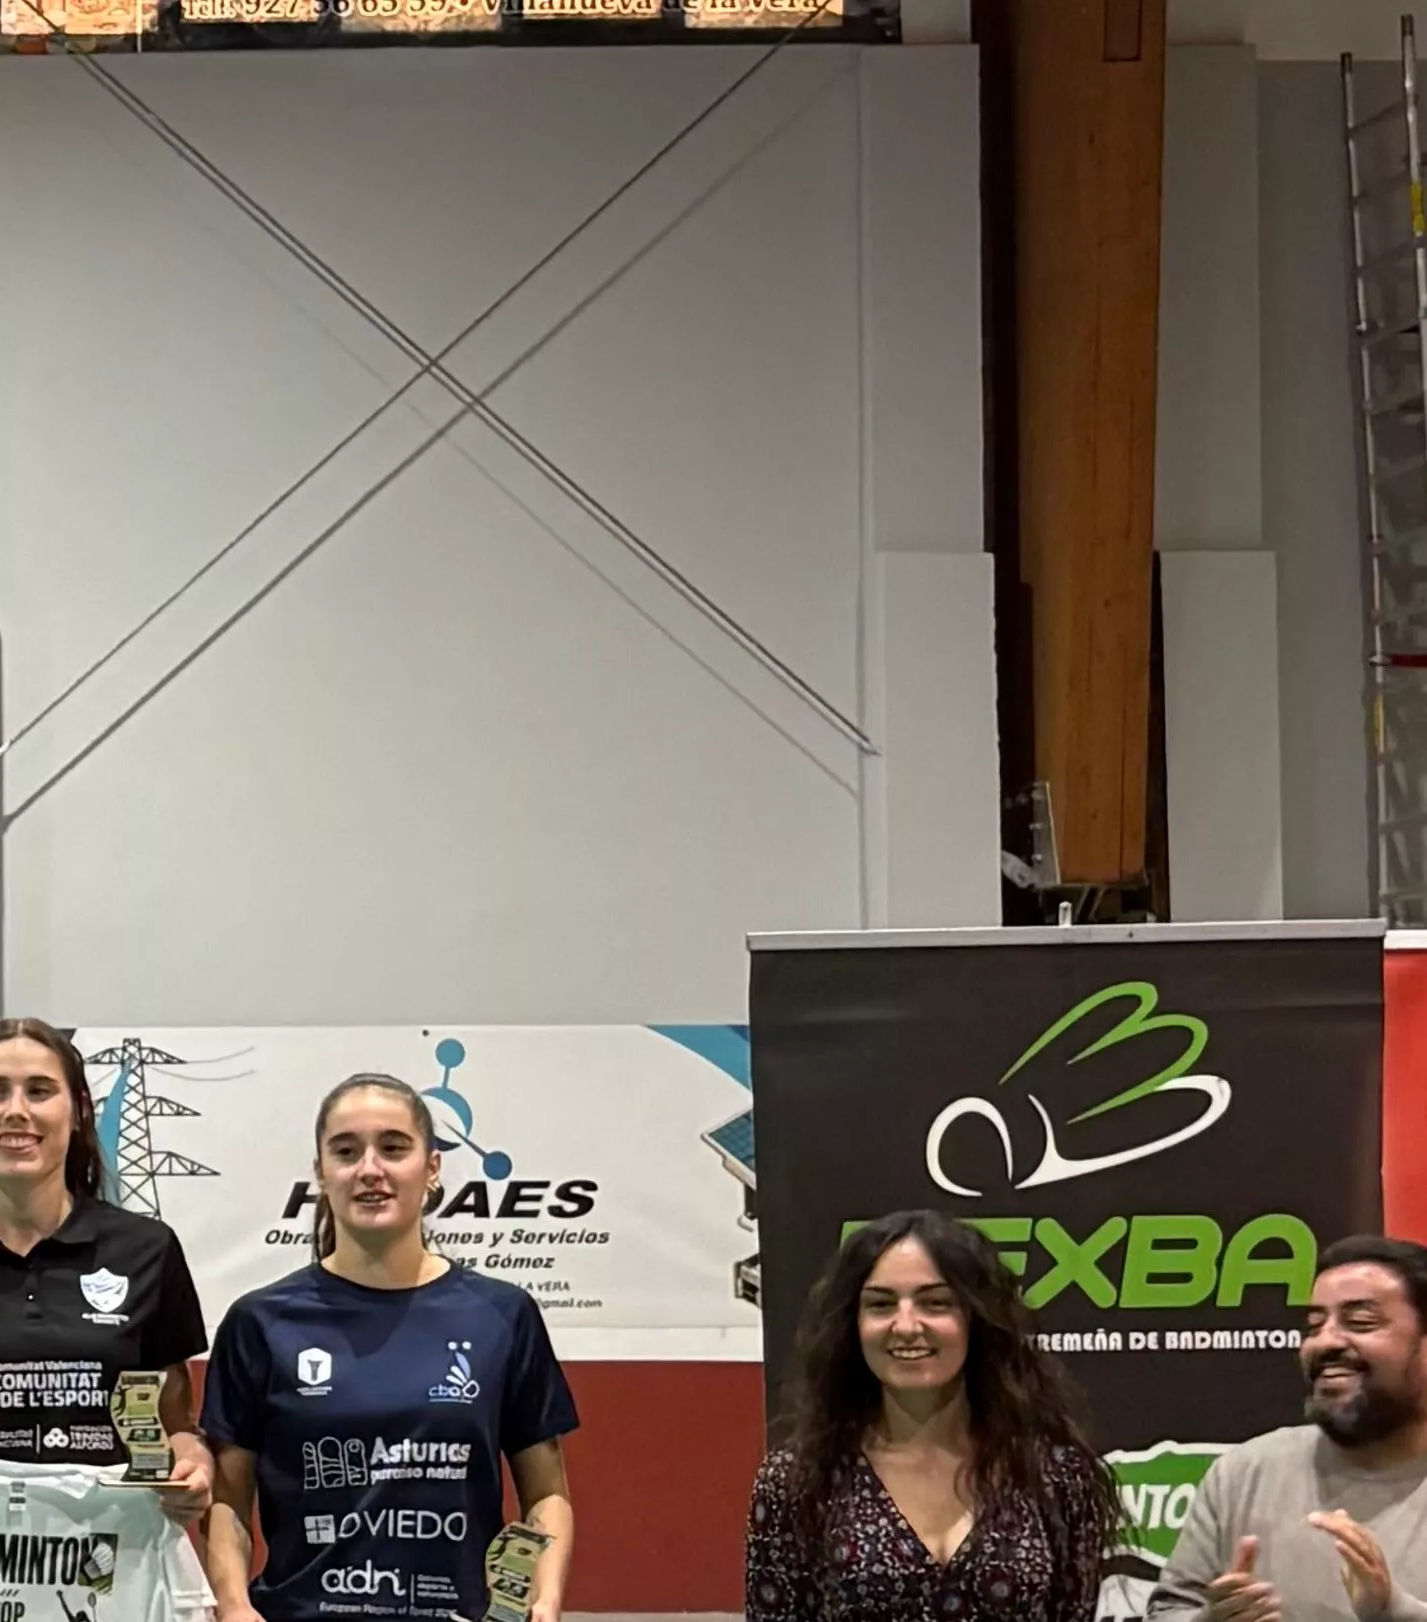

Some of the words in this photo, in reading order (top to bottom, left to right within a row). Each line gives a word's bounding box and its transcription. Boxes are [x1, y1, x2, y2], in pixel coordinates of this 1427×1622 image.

[491, 1230, 505, 1248] y
[510, 1229, 610, 1246] Servicios
[484, 1253, 555, 1270] Gómez
[1128, 1331, 1159, 1350] DE
[0, 1391, 25, 1408] DE
[339, 1509, 467, 1541] OVIEDO
